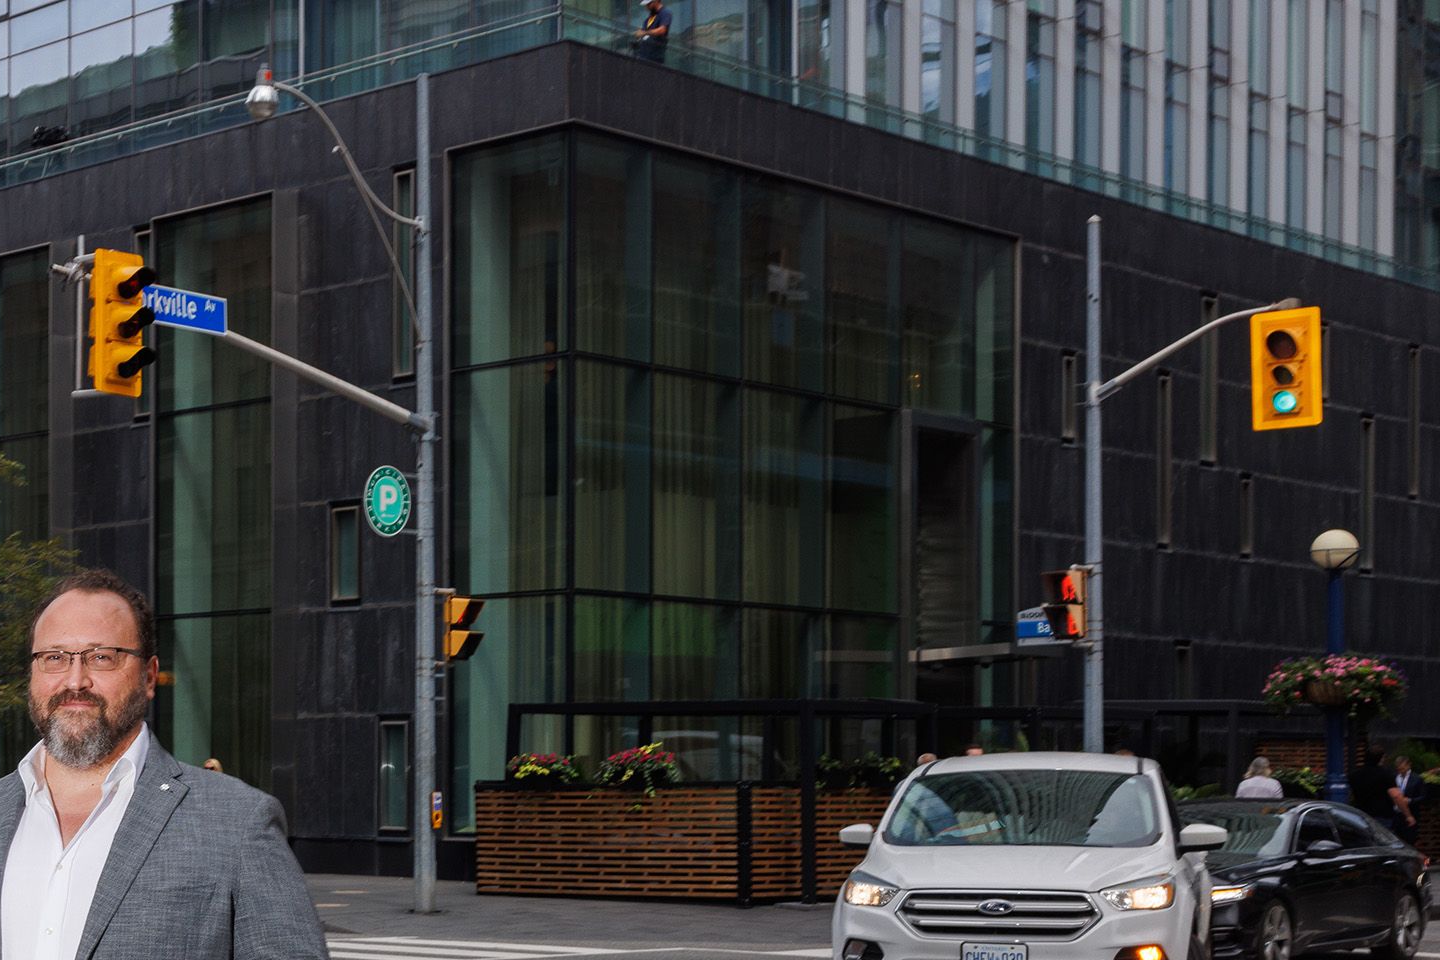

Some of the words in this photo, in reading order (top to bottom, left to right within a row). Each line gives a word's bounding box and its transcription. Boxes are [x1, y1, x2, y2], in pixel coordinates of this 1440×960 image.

[142, 289, 197, 320] orkville
[380, 485, 397, 512] P
[1037, 622, 1053, 635] Ba
